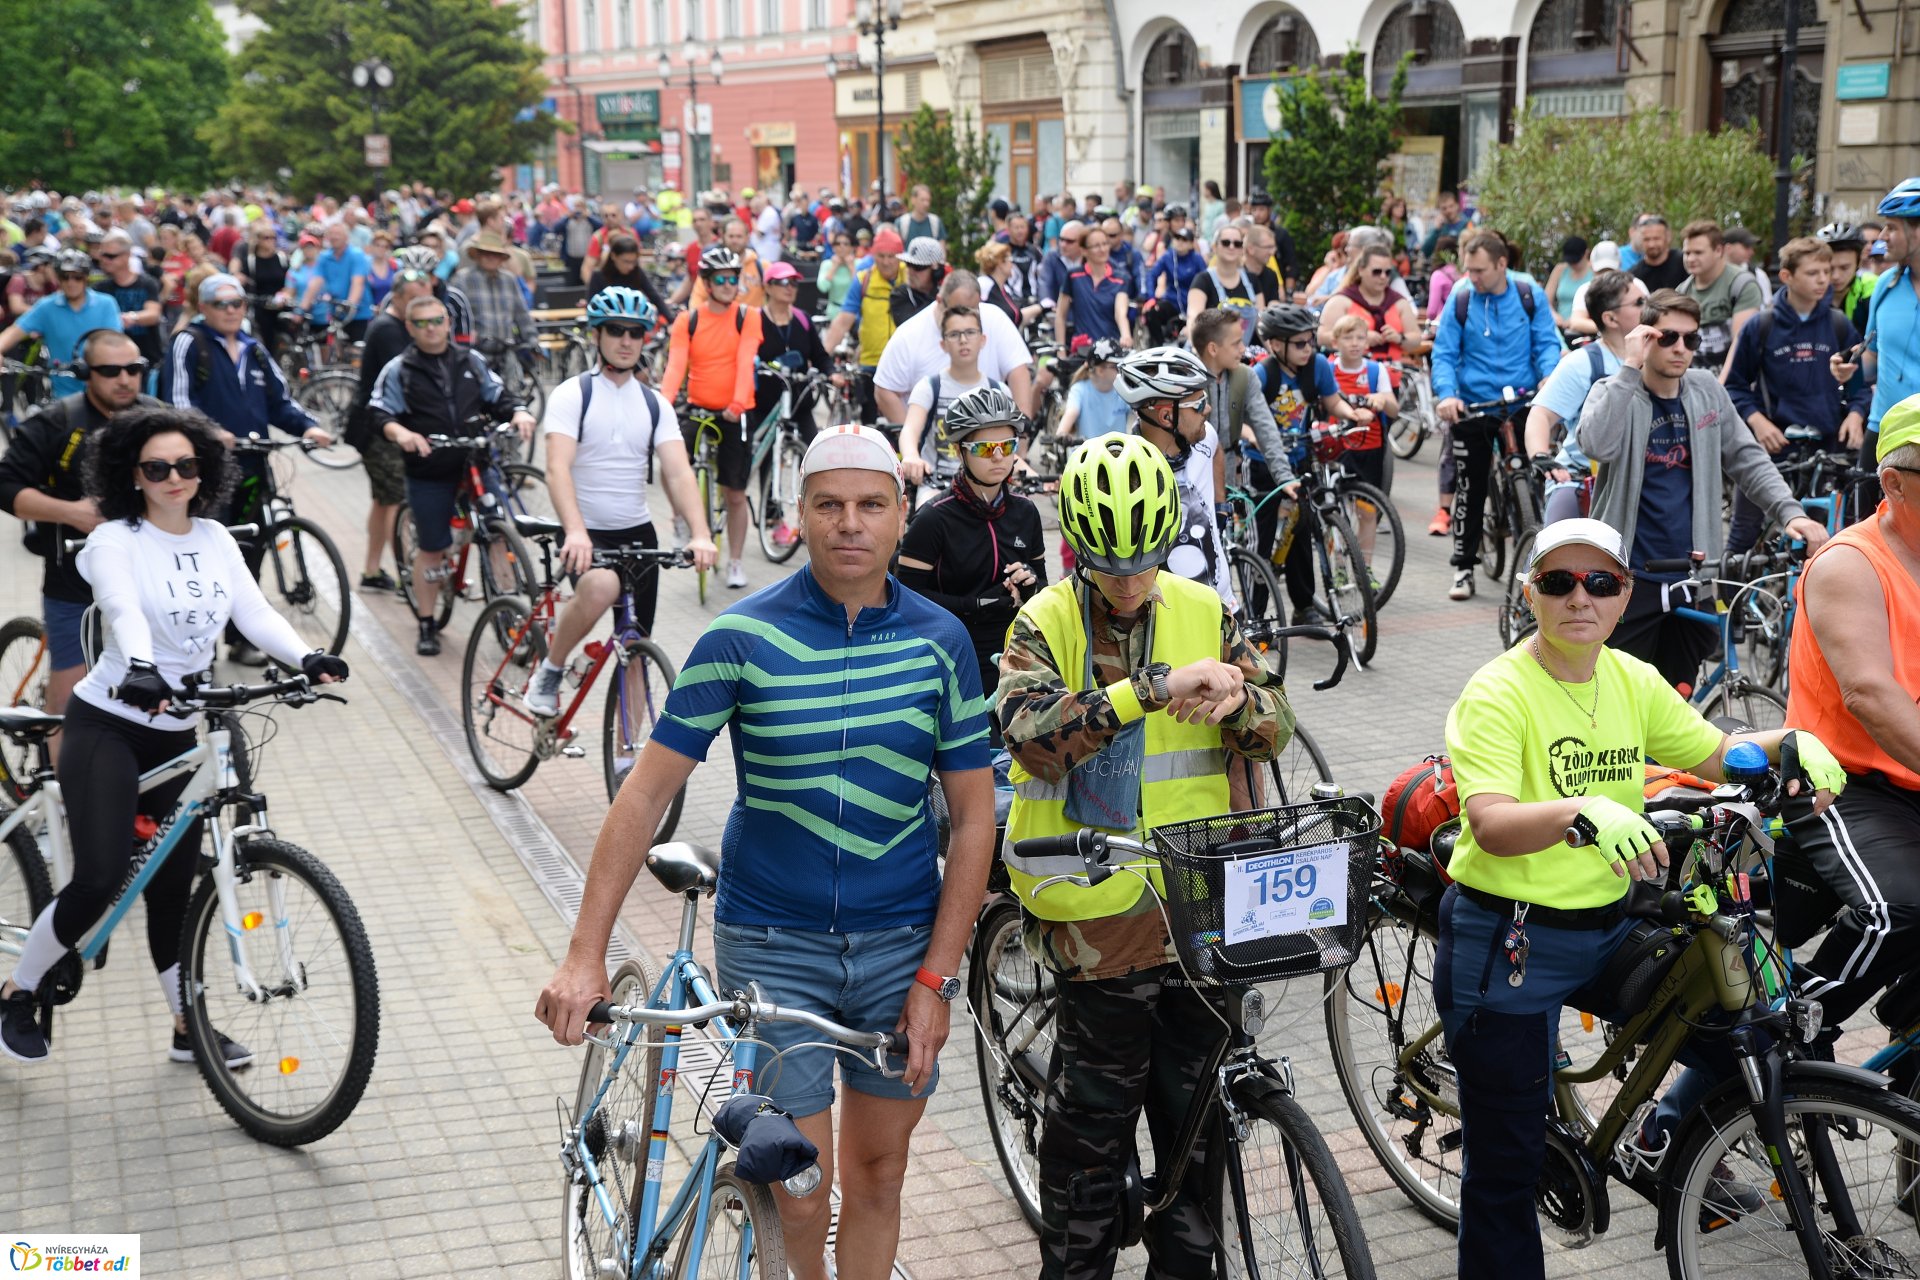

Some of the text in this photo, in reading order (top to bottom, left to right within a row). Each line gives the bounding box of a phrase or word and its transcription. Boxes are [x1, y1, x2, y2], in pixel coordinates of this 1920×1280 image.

[1083, 472, 1095, 518] ROCKRIDER
[1455, 460, 1470, 555] PURSUE
[173, 552, 200, 572] IT
[870, 632, 896, 642] MAAP
[1083, 756, 1140, 779] UCHAN
[1561, 745, 1641, 772] ZÖLD KERÉK
[1566, 765, 1633, 788] ALAPÍTVÁNY
[1248, 855, 1292, 871] DECATHLON
[1295, 847, 1333, 858] KERÉKPÁROS
[1320, 853, 1333, 861] NAP
[1253, 864, 1317, 906] 159
